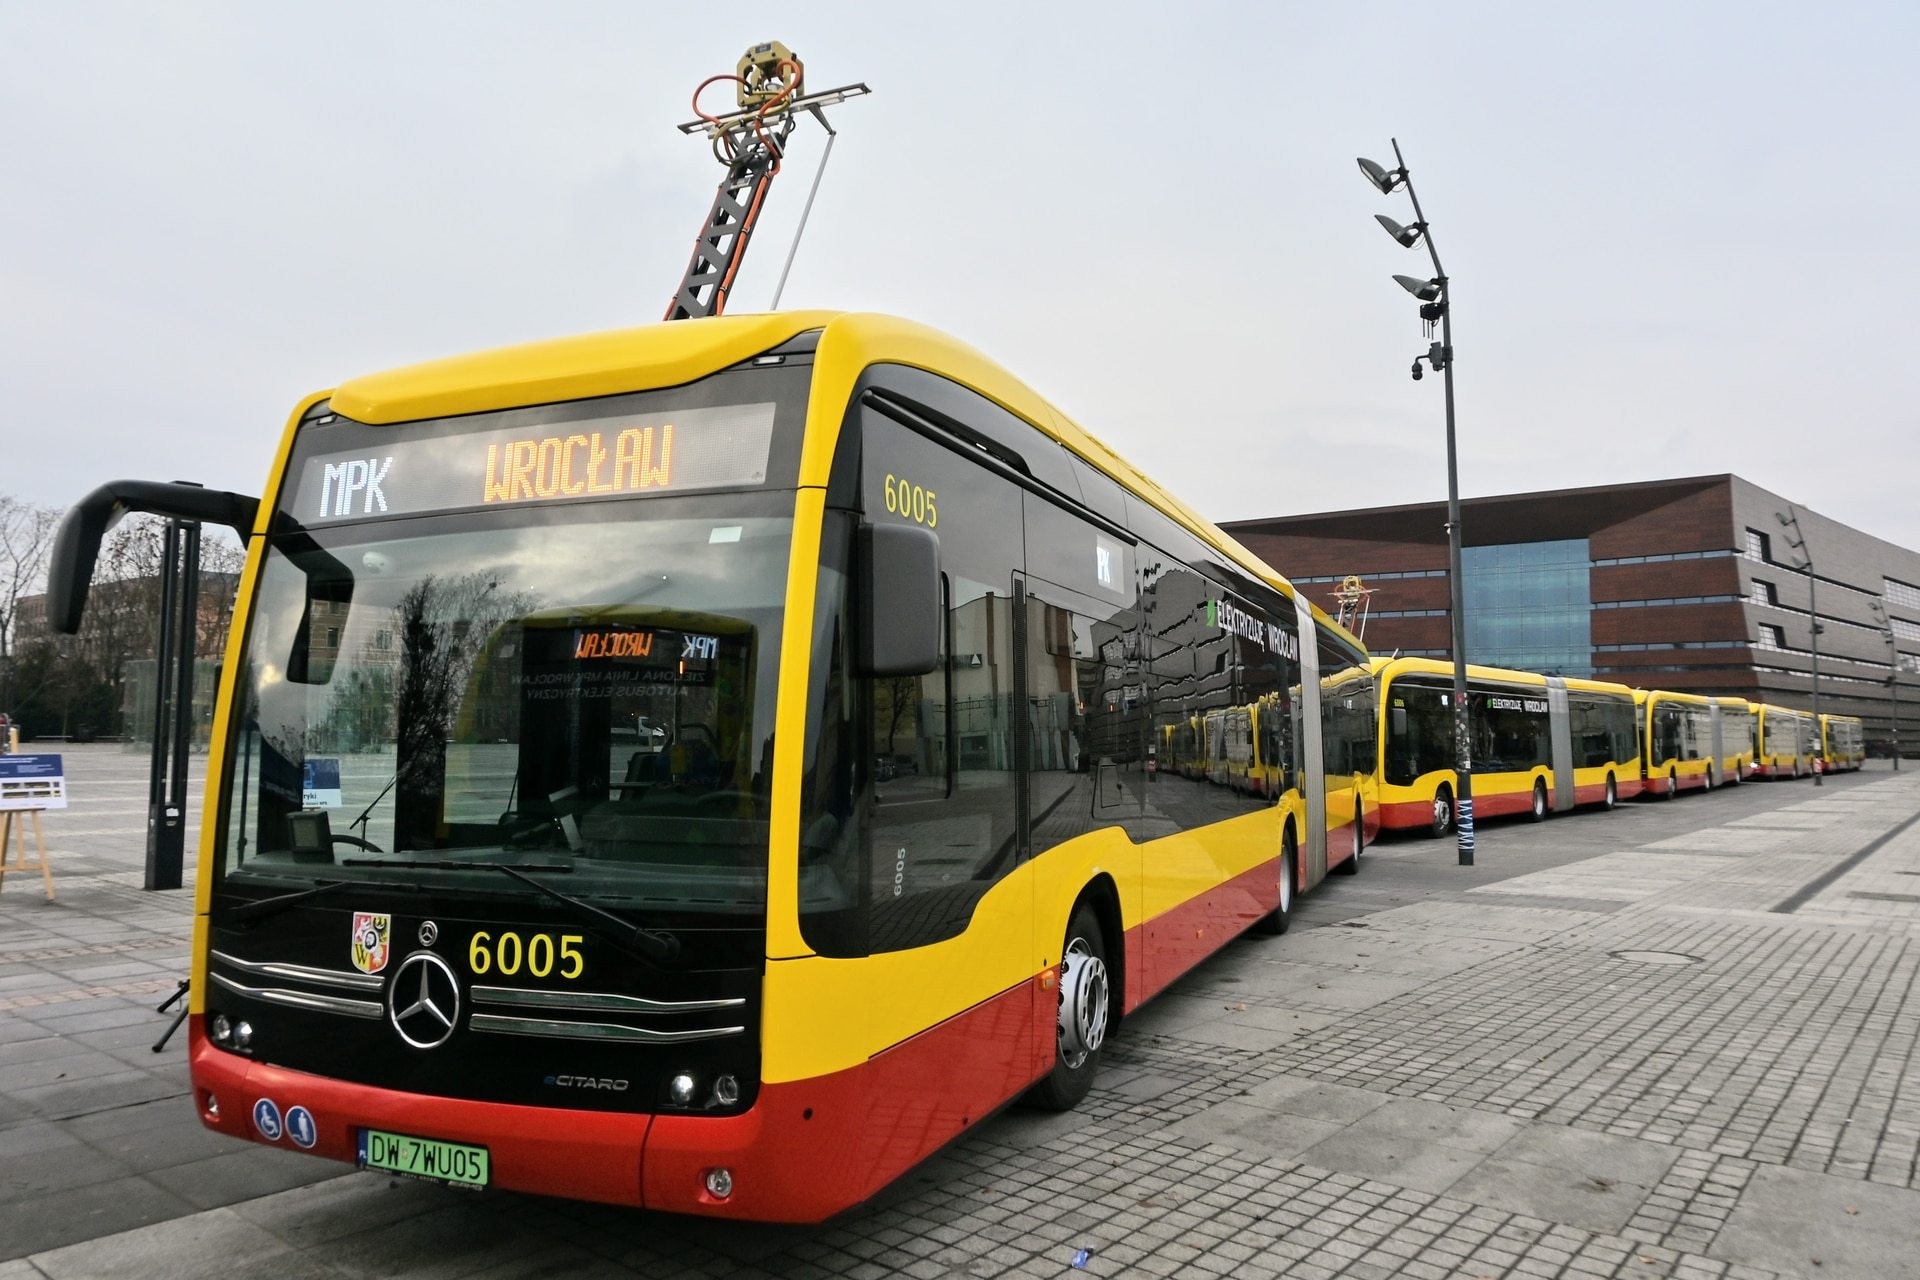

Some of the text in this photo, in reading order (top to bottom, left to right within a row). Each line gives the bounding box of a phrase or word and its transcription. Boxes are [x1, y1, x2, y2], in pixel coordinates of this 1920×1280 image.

[319, 424, 673, 517] MPK WROCŁAW
[884, 473, 937, 528] 6005
[894, 847, 906, 896] 6005
[469, 931, 584, 979] 6005
[372, 1135, 481, 1180] DW 7WU05
